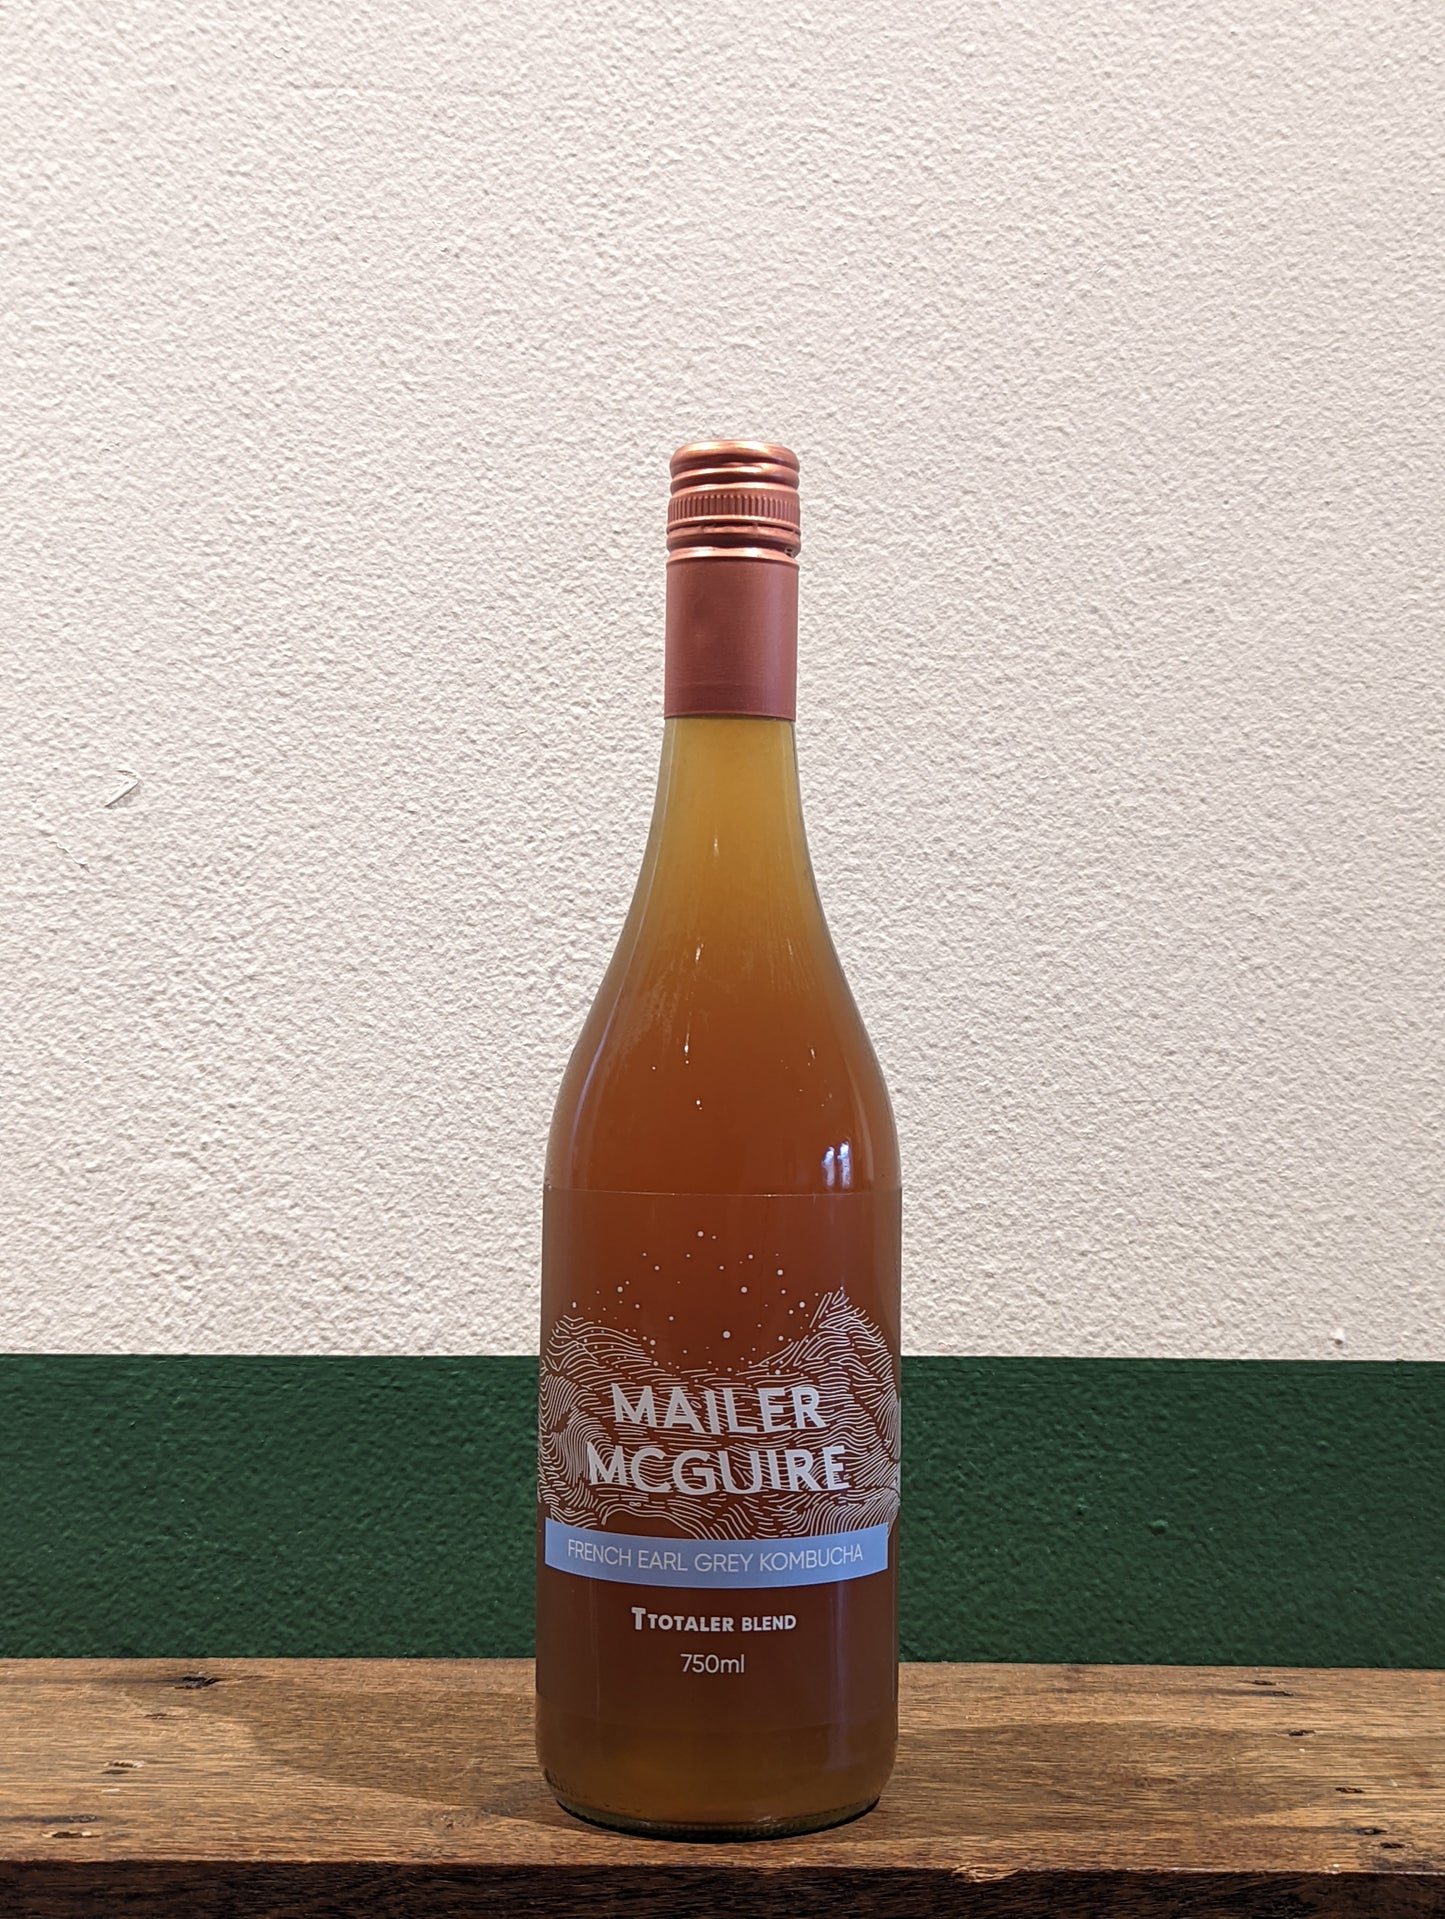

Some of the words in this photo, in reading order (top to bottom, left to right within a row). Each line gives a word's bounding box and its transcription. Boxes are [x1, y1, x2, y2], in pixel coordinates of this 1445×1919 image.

[611, 1382, 829, 1435] MAILER
[586, 1442, 851, 1495] MCGUIRE
[567, 1539, 632, 1567] FRENCH
[638, 1550, 688, 1571] EARL
[694, 1553, 754, 1572] GREY
[759, 1544, 864, 1571] KOMBUCHA
[741, 1614, 797, 1631] BLEND
[680, 1654, 745, 1673] 750ml
